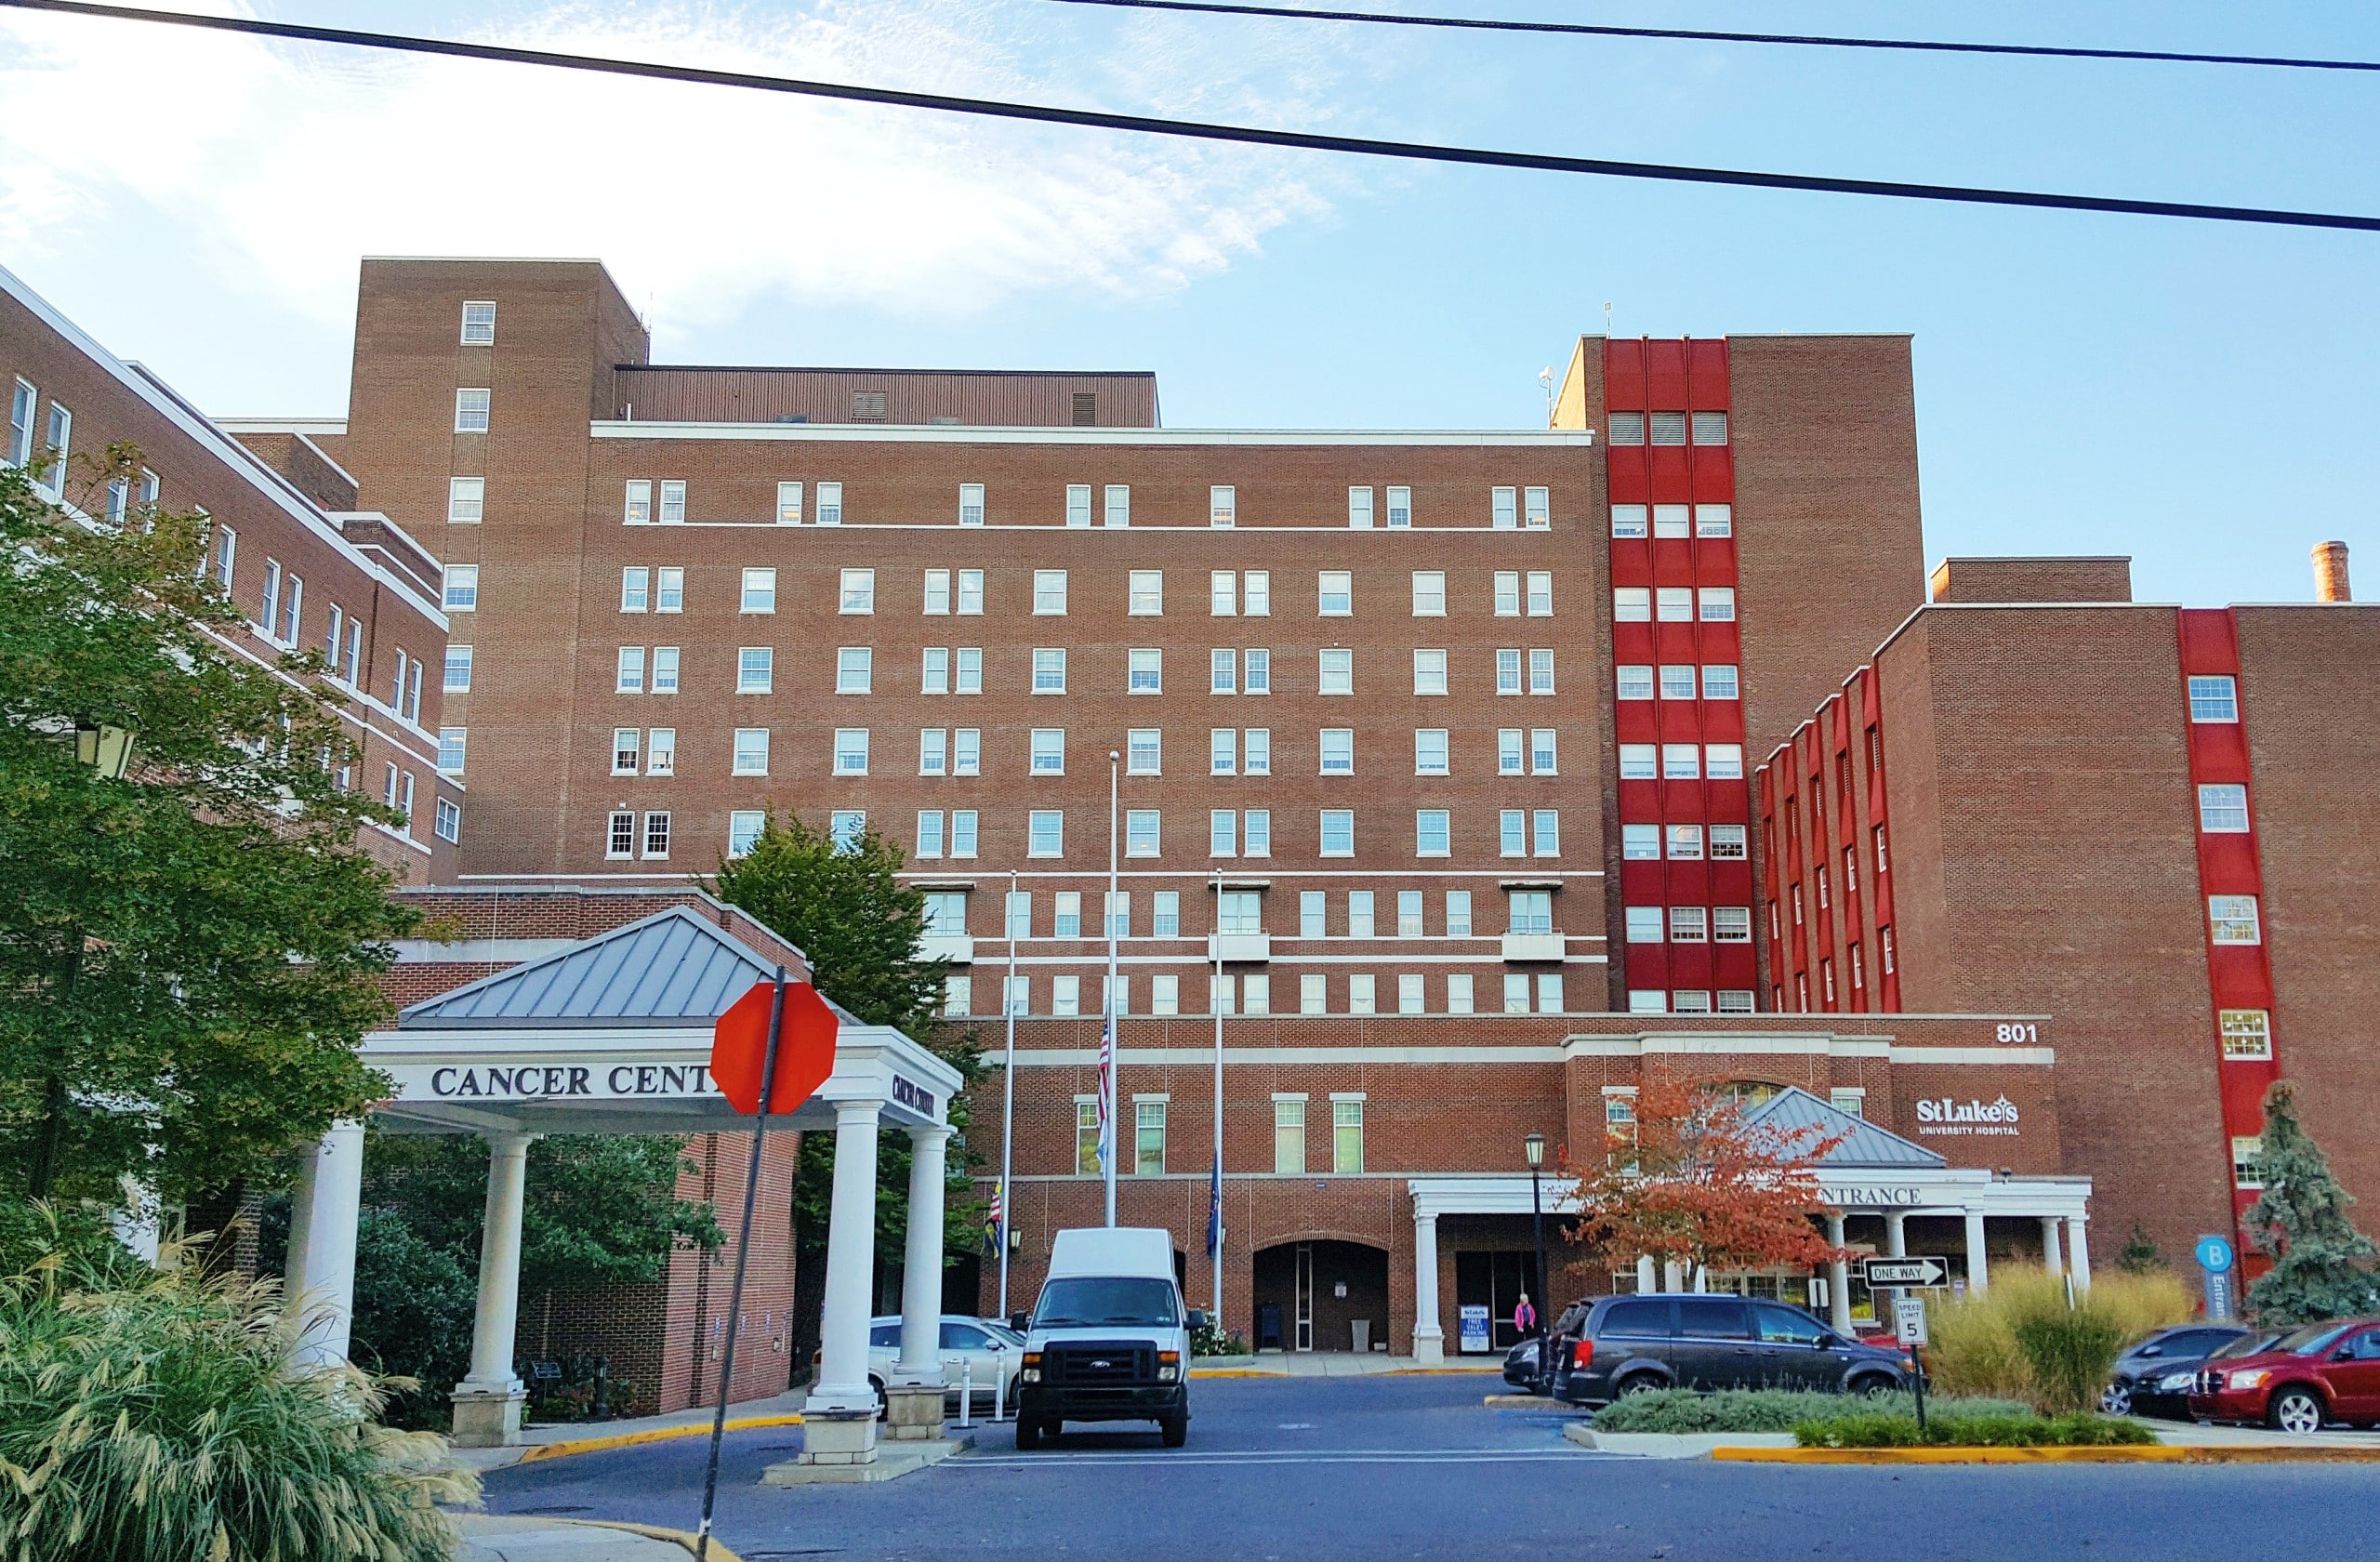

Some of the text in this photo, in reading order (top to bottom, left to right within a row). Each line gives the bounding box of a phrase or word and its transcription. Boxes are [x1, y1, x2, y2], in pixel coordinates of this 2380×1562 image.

[1997, 1024, 2037, 1043] 801
[431, 1066, 722, 1095] CANCER CENT
[1919, 1126, 2020, 1136] UNIVERSITY HOSPITAL
[1822, 1187, 1923, 1205] NTRANCE
[2209, 1245, 2224, 1265] B
[1874, 1267, 1922, 1279] ONE WAY
[1898, 1304, 1922, 1312] SPEED
[1907, 1323, 1918, 1337] 5
